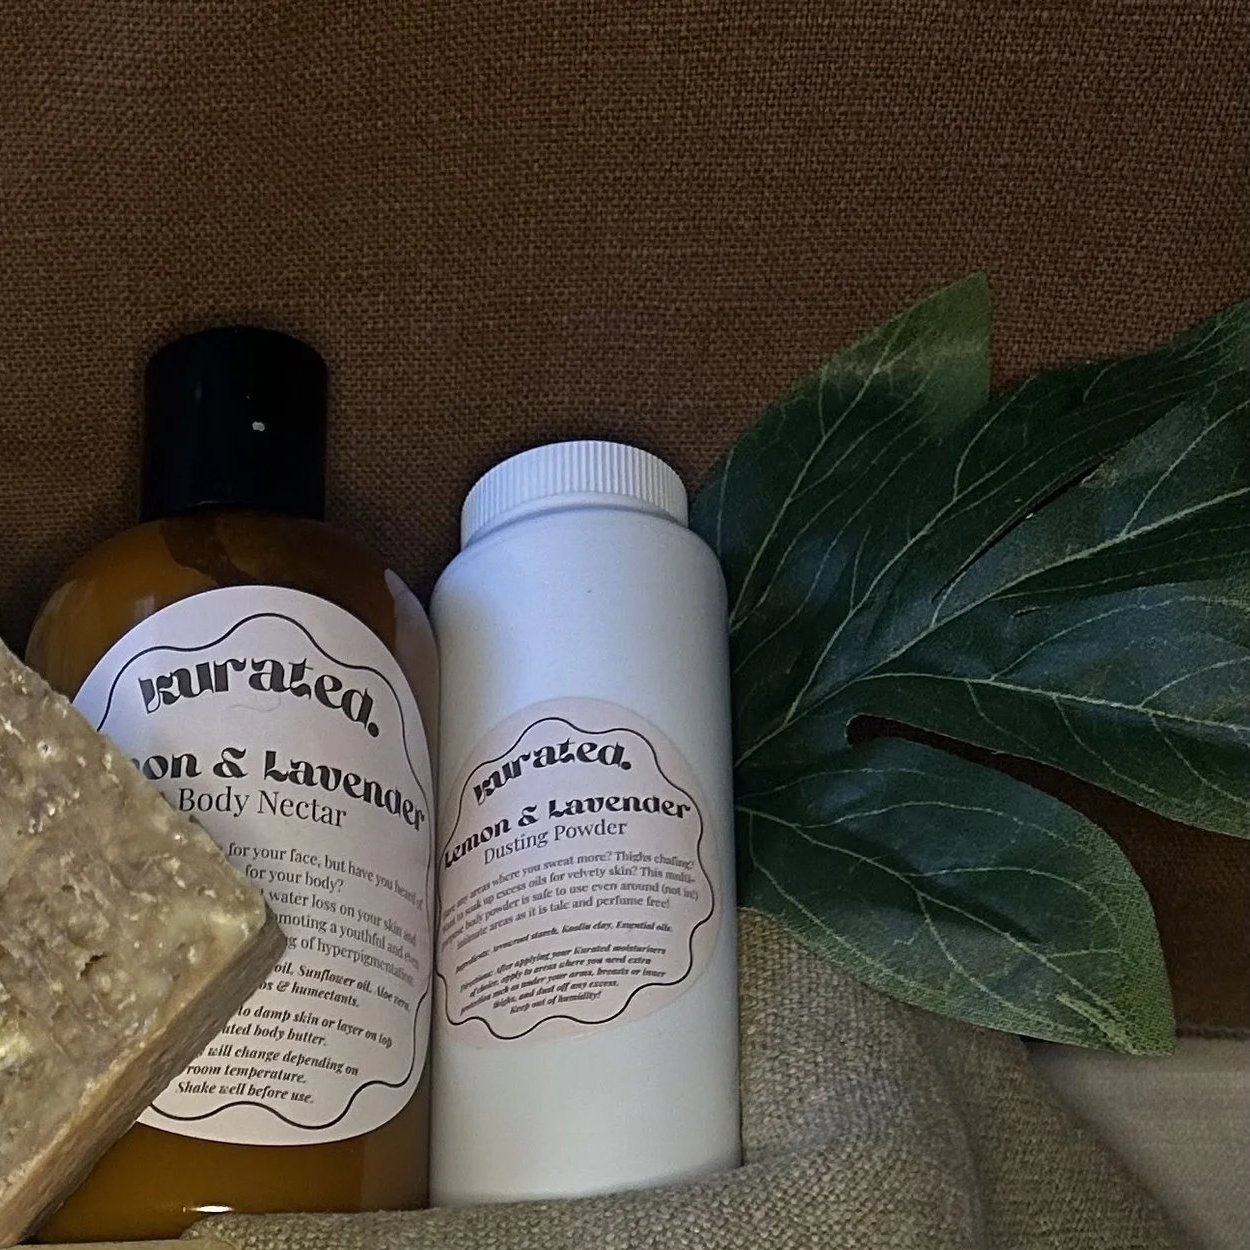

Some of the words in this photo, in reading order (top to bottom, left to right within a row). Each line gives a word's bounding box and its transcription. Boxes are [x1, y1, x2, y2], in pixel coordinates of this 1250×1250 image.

[213, 748, 248, 778] &
[264, 750, 426, 831] Lavender
[179, 786, 250, 817] Body
[257, 790, 347, 828] Nectar
[444, 817, 511, 869] Lemon
[518, 804, 538, 828] &
[548, 796, 691, 819] Lavender
[484, 829, 549, 865] Dusting
[554, 818, 627, 841] Powder
[228, 842, 249, 857] for
[252, 846, 287, 860] your
[324, 855, 347, 873] but
[349, 861, 374, 882] have
[375, 874, 393, 890] you
[245, 864, 266, 879] for
[269, 869, 302, 885] your
[305, 871, 345, 893] body?
[492, 869, 520, 886] where
[522, 863, 541, 875] you
[543, 856, 574, 868] sweat
[577, 851, 612, 863] more?
[615, 851, 651, 862] Thighs
[496, 883, 526, 899] excess
[529, 876, 547, 888] oils
[550, 871, 565, 883] for
[567, 868, 606, 879] velvety
[609, 865, 638, 876] skin?
[640, 867, 663, 878] This
[269, 889, 309, 907] water
[312, 894, 336, 912] loss
[339, 904, 354, 917] on
[357, 908, 383, 927] your
[485, 899, 520, 920] powder
[532, 888, 552, 900] safe
[555, 887, 566, 896] to
[569, 885, 588, 894] use
[591, 883, 617, 892] even
[620, 882, 659, 892] around
[515, 911, 526, 922] as
[528, 908, 536, 918] it
[538, 904, 548, 915] is
[550, 900, 570, 911] talc
[572, 896, 593, 907] and
[596, 895, 644, 907] perfume
[274, 914, 327, 933] moting
[329, 923, 337, 933] a
[339, 925, 386, 950] youthful
[300, 935, 315, 950] of
[297, 965, 356, 988] Sunflower
[276, 981, 290, 993] &
[291, 982, 360, 1008] humectants.
[253, 1024, 285, 1041] body
[254, 1005, 291, 1023] damp
[293, 1010, 319, 1026] skin
[321, 1016, 336, 1028] or
[337, 1018, 364, 1037] layer
[365, 1029, 377, 1041] on
[378, 1032, 393, 1049] top
[186, 1065, 222, 1075] room
[224, 1064, 307, 1083] temperature.
[207, 1044, 232, 1058] will
[234, 1046, 280, 1062] change
[282, 1051, 344, 1074] depending
[345, 1064, 359, 1076] on
[177, 1081, 217, 1094] Shake
[219, 1083, 245, 1096] well
[247, 1084, 289, 1100] before
